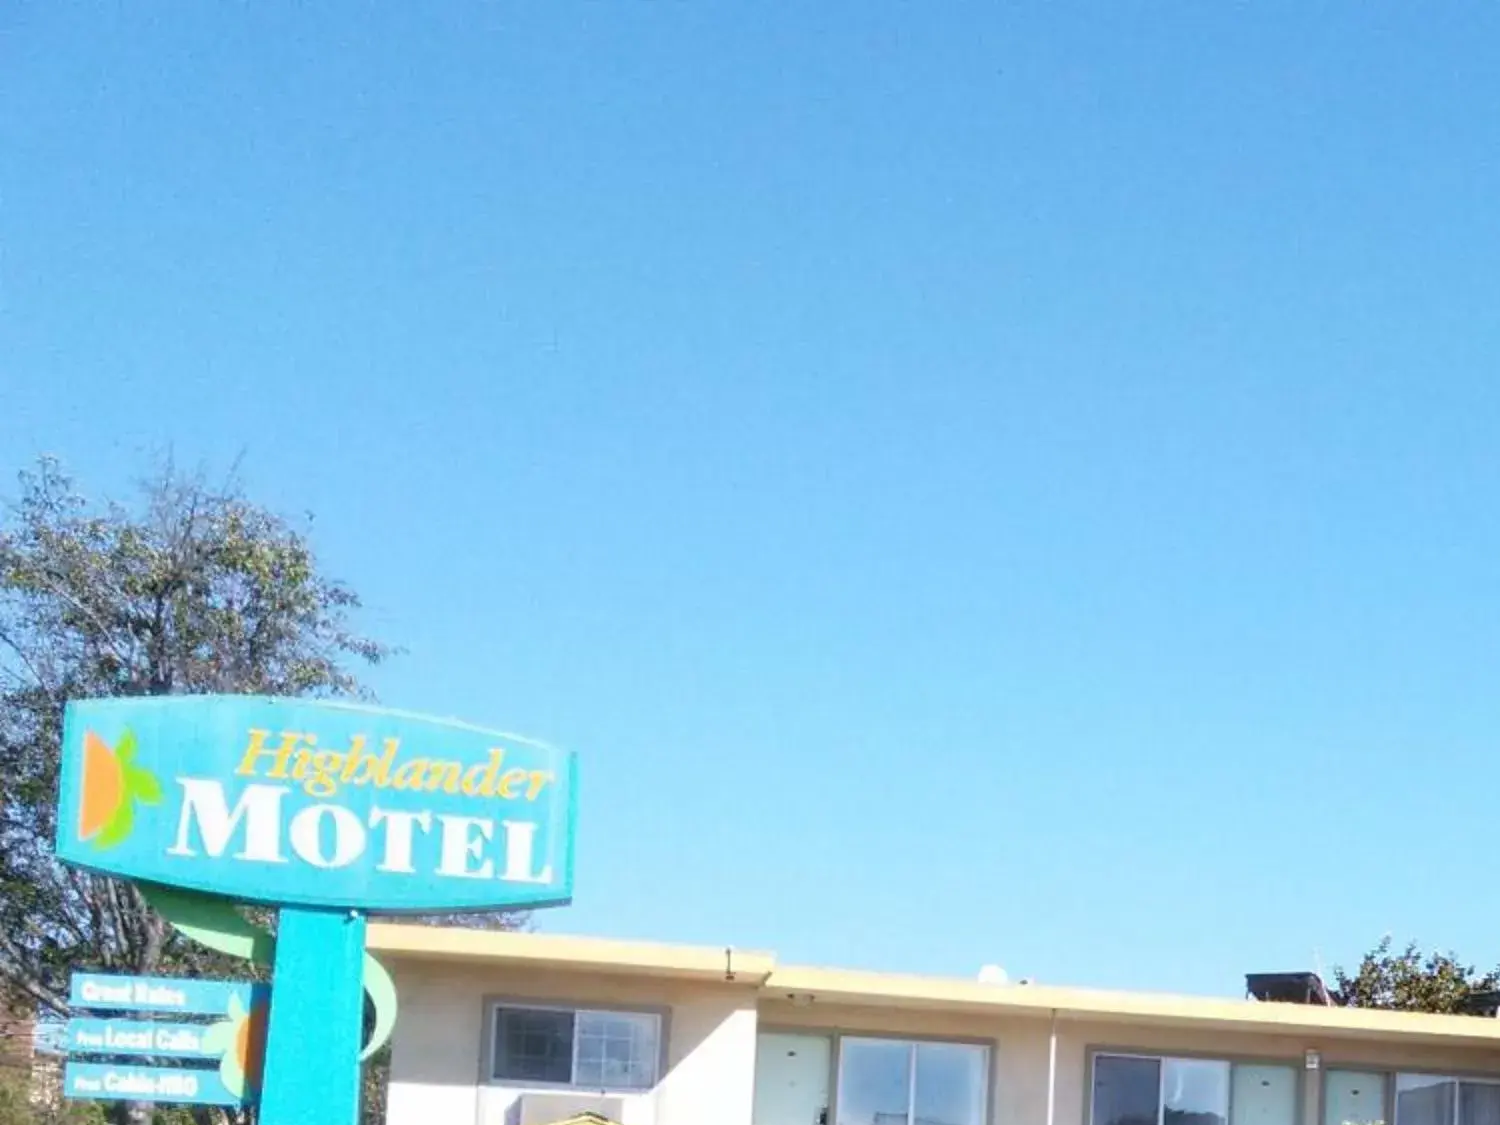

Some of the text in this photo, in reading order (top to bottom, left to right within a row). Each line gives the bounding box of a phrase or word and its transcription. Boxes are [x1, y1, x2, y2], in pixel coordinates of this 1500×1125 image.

[238, 729, 555, 802] Highlander
[168, 777, 553, 885] MOTEL
[105, 1026, 154, 1049] Local
[156, 1029, 199, 1050] Calls
